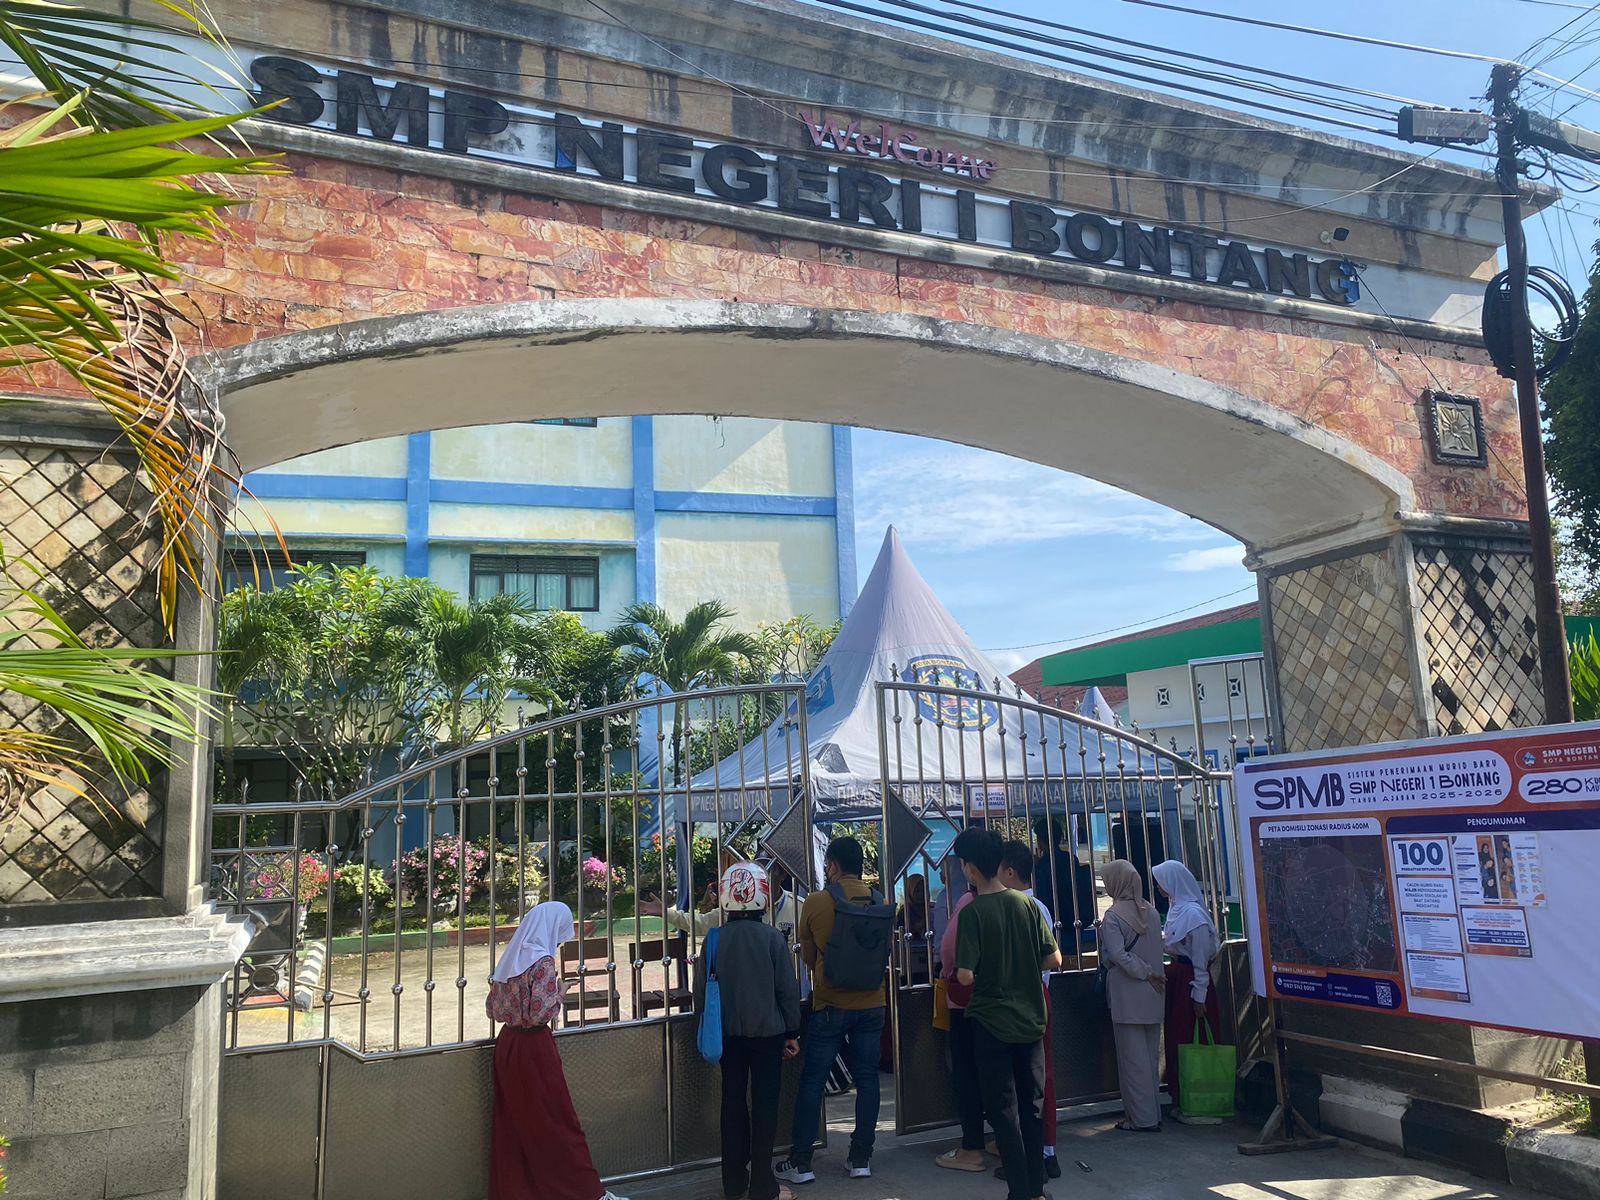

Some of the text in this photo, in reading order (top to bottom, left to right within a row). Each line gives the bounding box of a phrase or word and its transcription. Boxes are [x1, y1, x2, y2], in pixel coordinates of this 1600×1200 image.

[247, 55, 509, 154] SMP
[555, 113, 922, 232] NEGERI
[1009, 200, 1360, 306] BONTANG
[1542, 745, 1597, 758] SMP NEGERI
[1347, 759, 1497, 779] SISTEM PENERIMAAN MURID BARU
[1254, 773, 1345, 810] SPMB
[1349, 771, 1500, 794] SMP NEGERI 1 BONTANG
[1527, 777, 1583, 796] 280
[700, 792, 726, 811] NEGRI
[1421, 788, 1503, 800] 2025-2026
[1281, 824, 1307, 832] DOMISILI
[1307, 823, 1329, 832] ZONASI
[1329, 822, 1351, 831] RADIUS
[1352, 822, 1370, 830] 400M
[1466, 817, 1526, 826] PENGUMUMAN
[1398, 842, 1444, 866] 100
